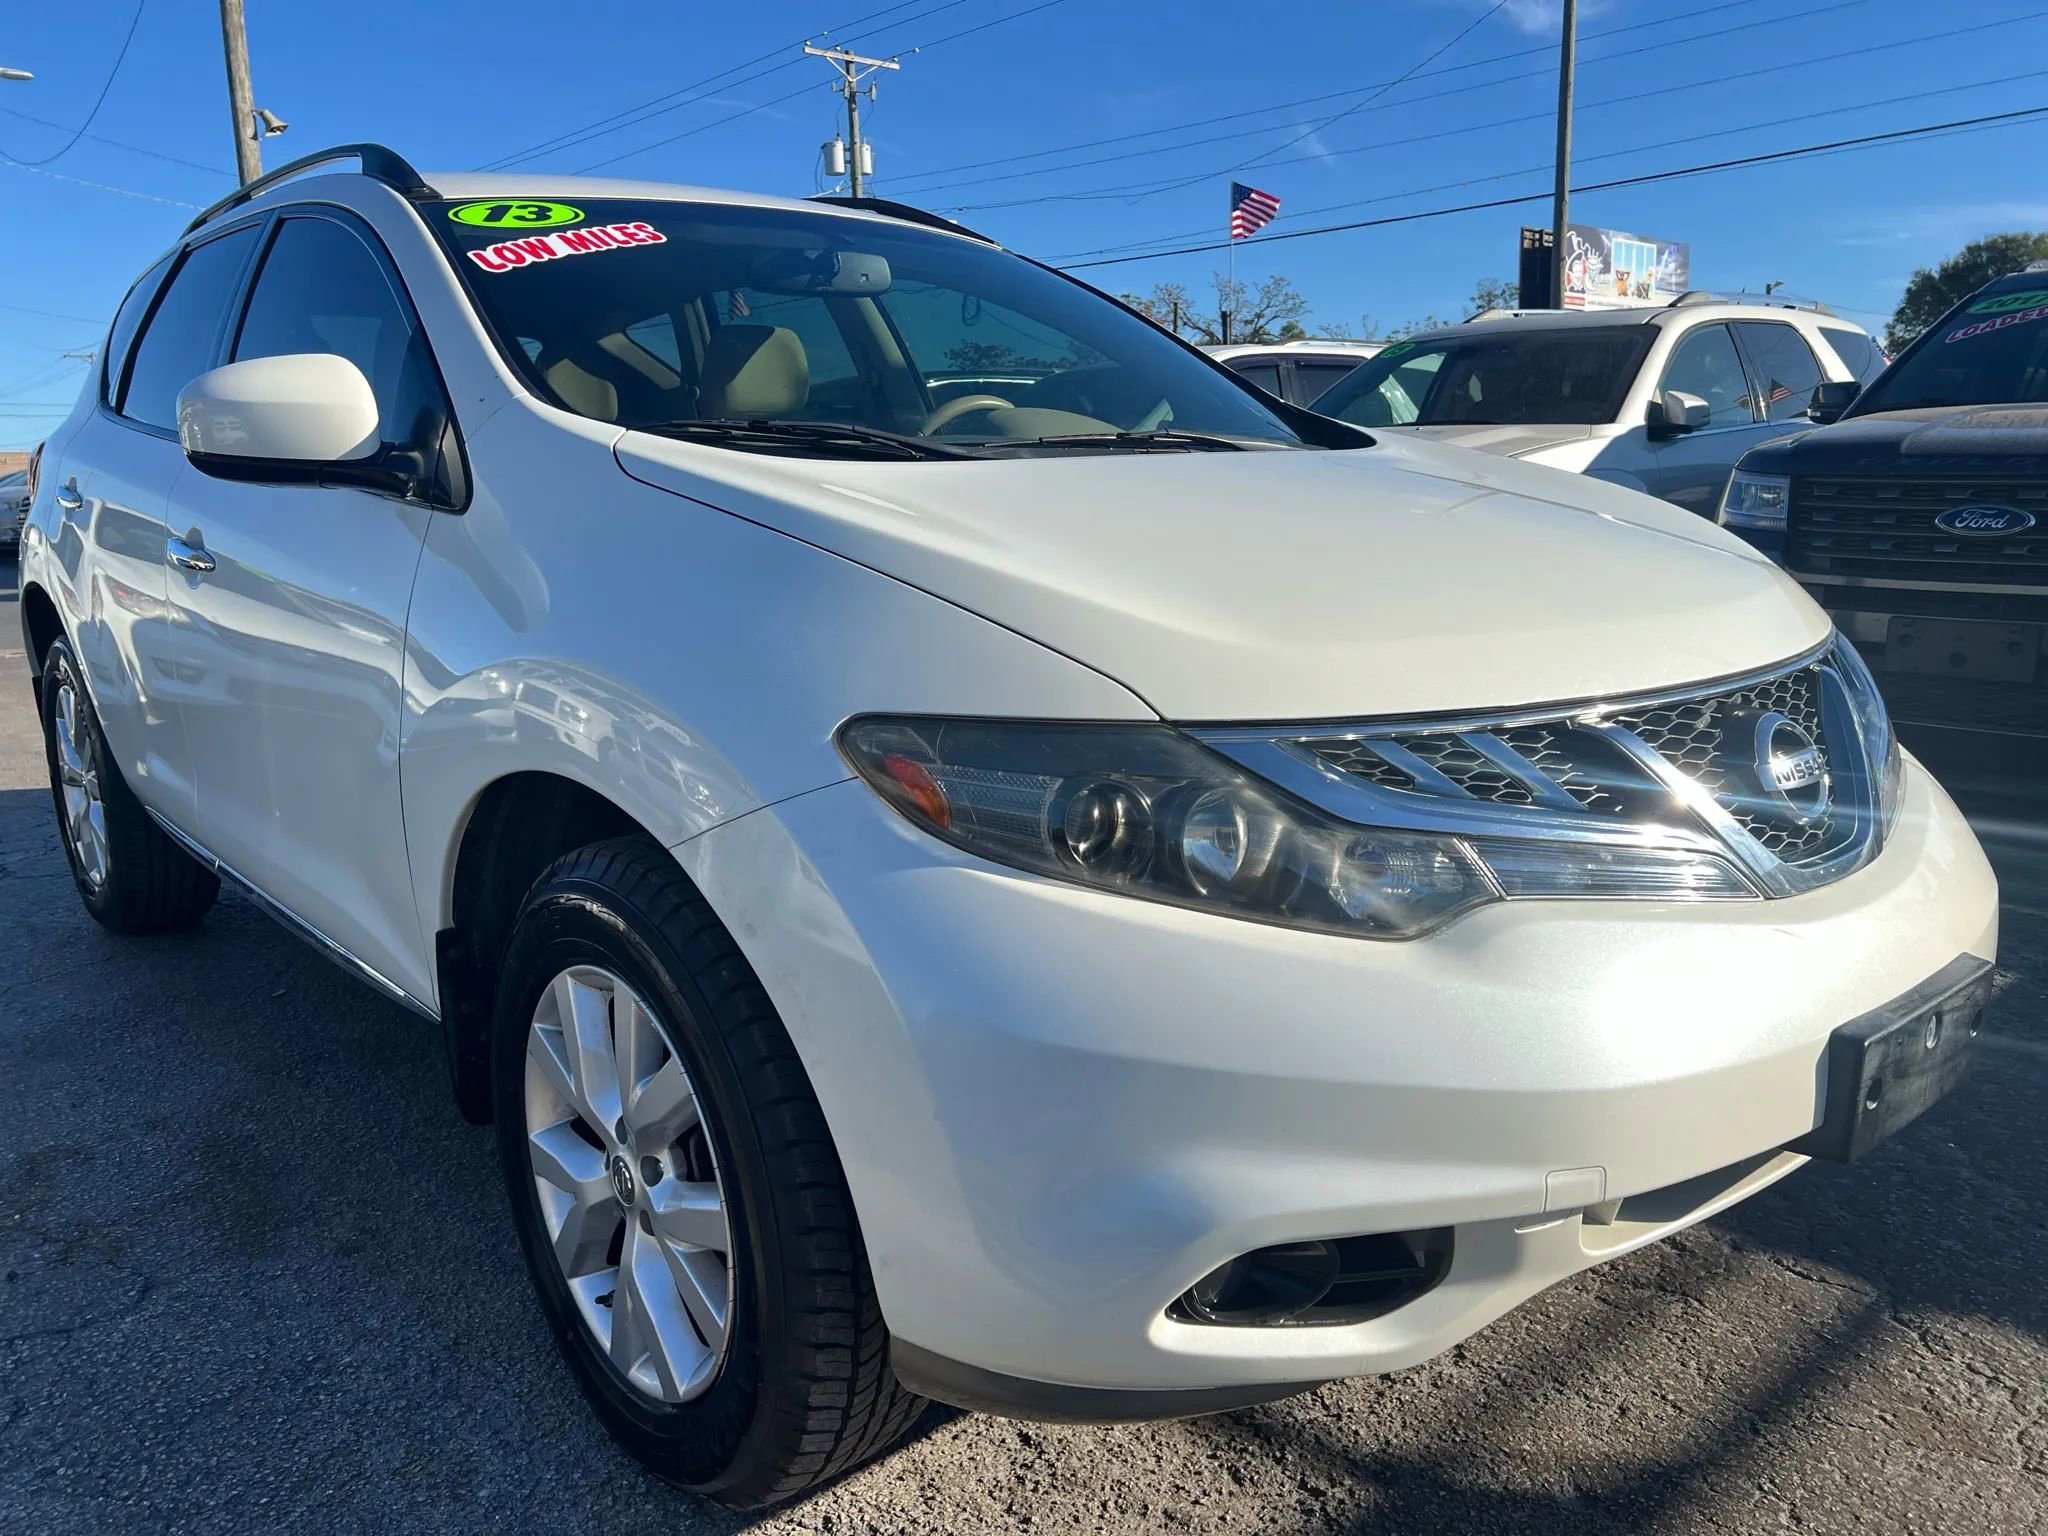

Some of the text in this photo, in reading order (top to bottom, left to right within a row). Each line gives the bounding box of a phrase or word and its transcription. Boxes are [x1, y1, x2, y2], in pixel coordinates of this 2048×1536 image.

[483, 203, 553, 223] 13
[472, 222, 664, 271] LOW MILES
[1955, 508, 2011, 529] Ford
